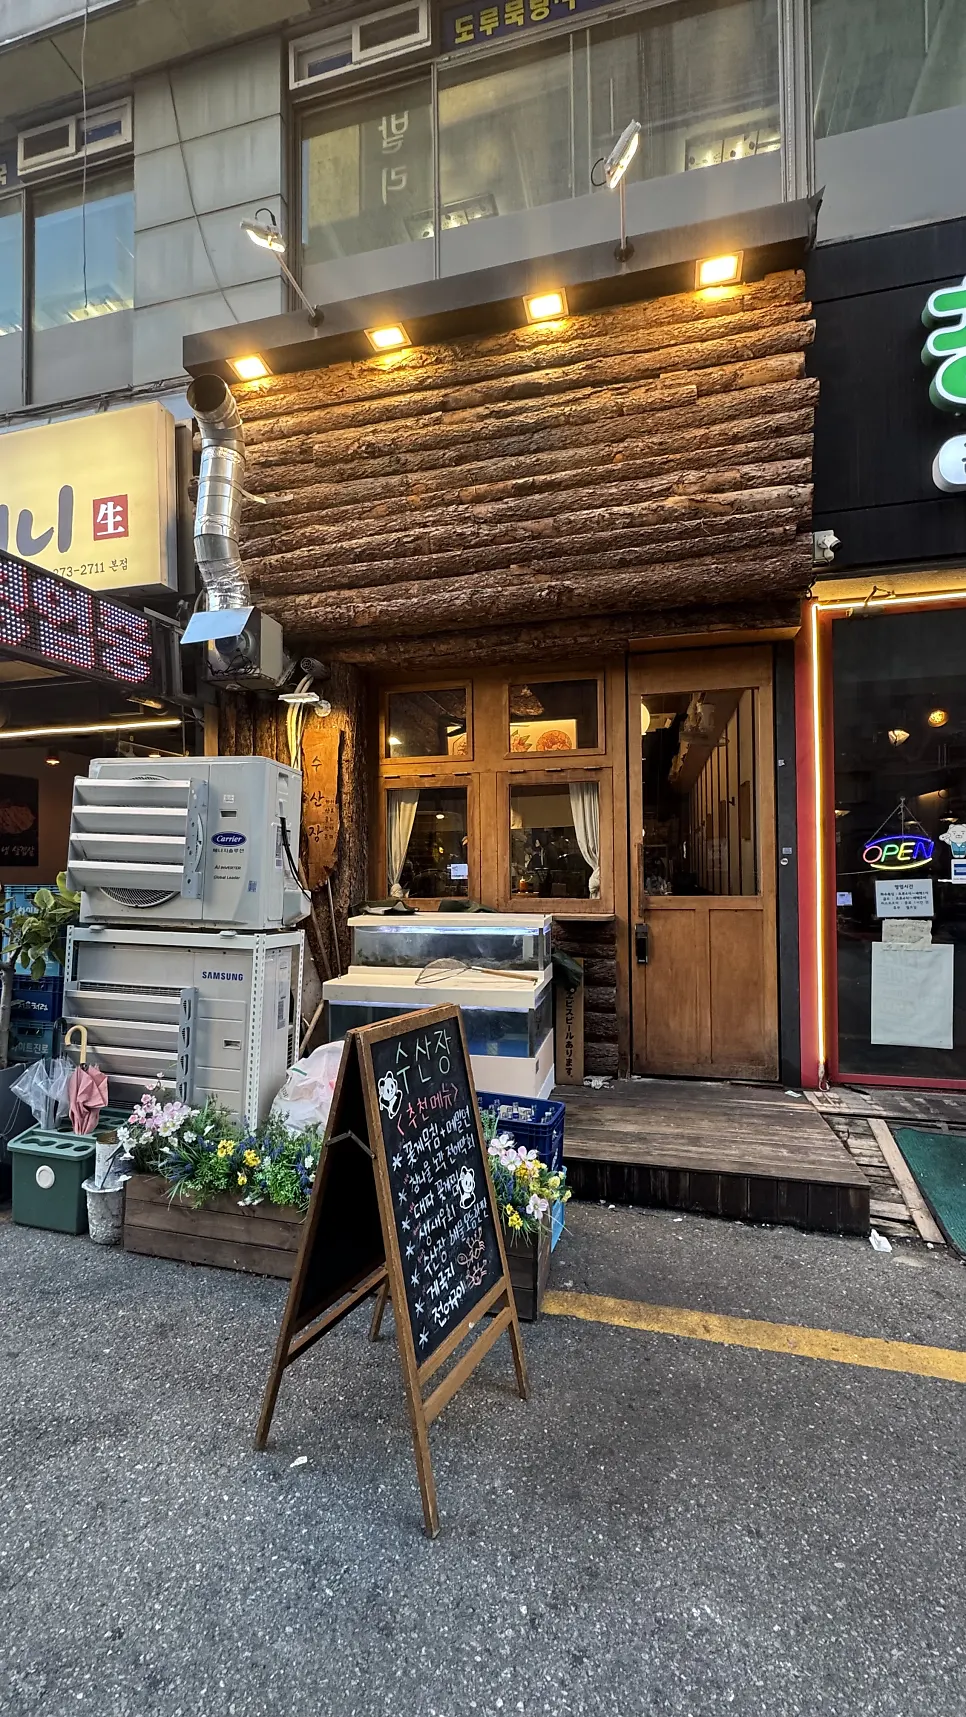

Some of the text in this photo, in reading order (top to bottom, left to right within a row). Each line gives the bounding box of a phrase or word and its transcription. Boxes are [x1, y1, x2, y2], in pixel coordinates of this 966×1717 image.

[96, 501, 126, 537] 生
[109, 558, 128, 573] 본점
[216, 835, 243, 843] Carrier
[862, 841, 935, 864] OPEN
[202, 971, 244, 982] SAMSUNG
[395, 1029, 452, 1095] 수산장
[413, 1190, 435, 1219] 대파
[418, 1203, 457, 1247] 생새우회
[423, 1236, 448, 1278] 수산장
[426, 1262, 455, 1300] 게국지
[431, 1280, 466, 1328] 전어구이
